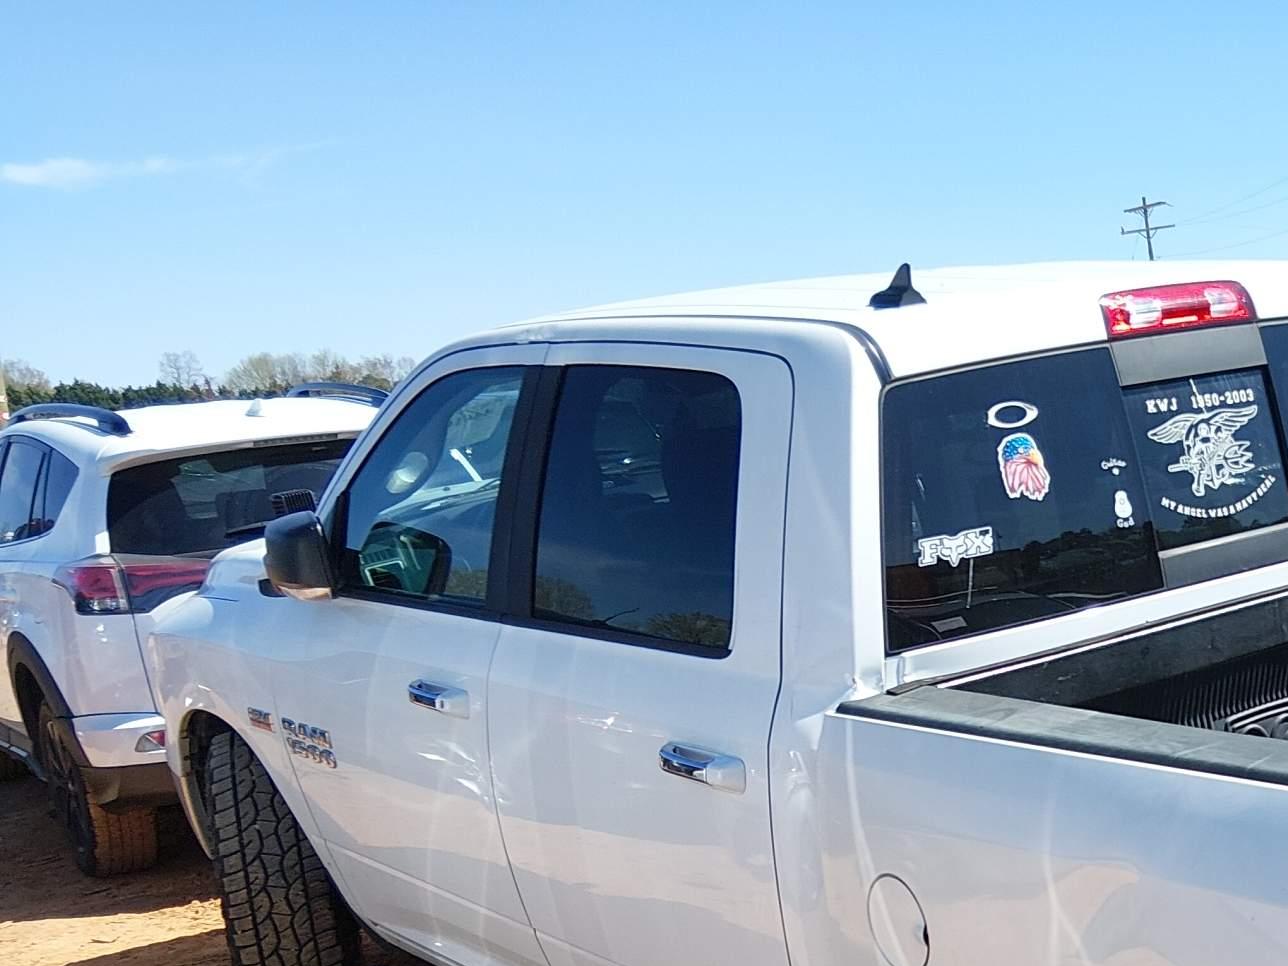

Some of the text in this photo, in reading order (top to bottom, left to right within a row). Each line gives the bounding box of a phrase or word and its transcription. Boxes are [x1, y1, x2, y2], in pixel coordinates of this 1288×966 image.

[1145, 397, 1178, 413] KWJ
[1161, 496, 1176, 510] MY
[1207, 506, 1229, 518] WAS
[1234, 491, 1258, 513] NAVY
[281, 717, 332, 749] RAM
